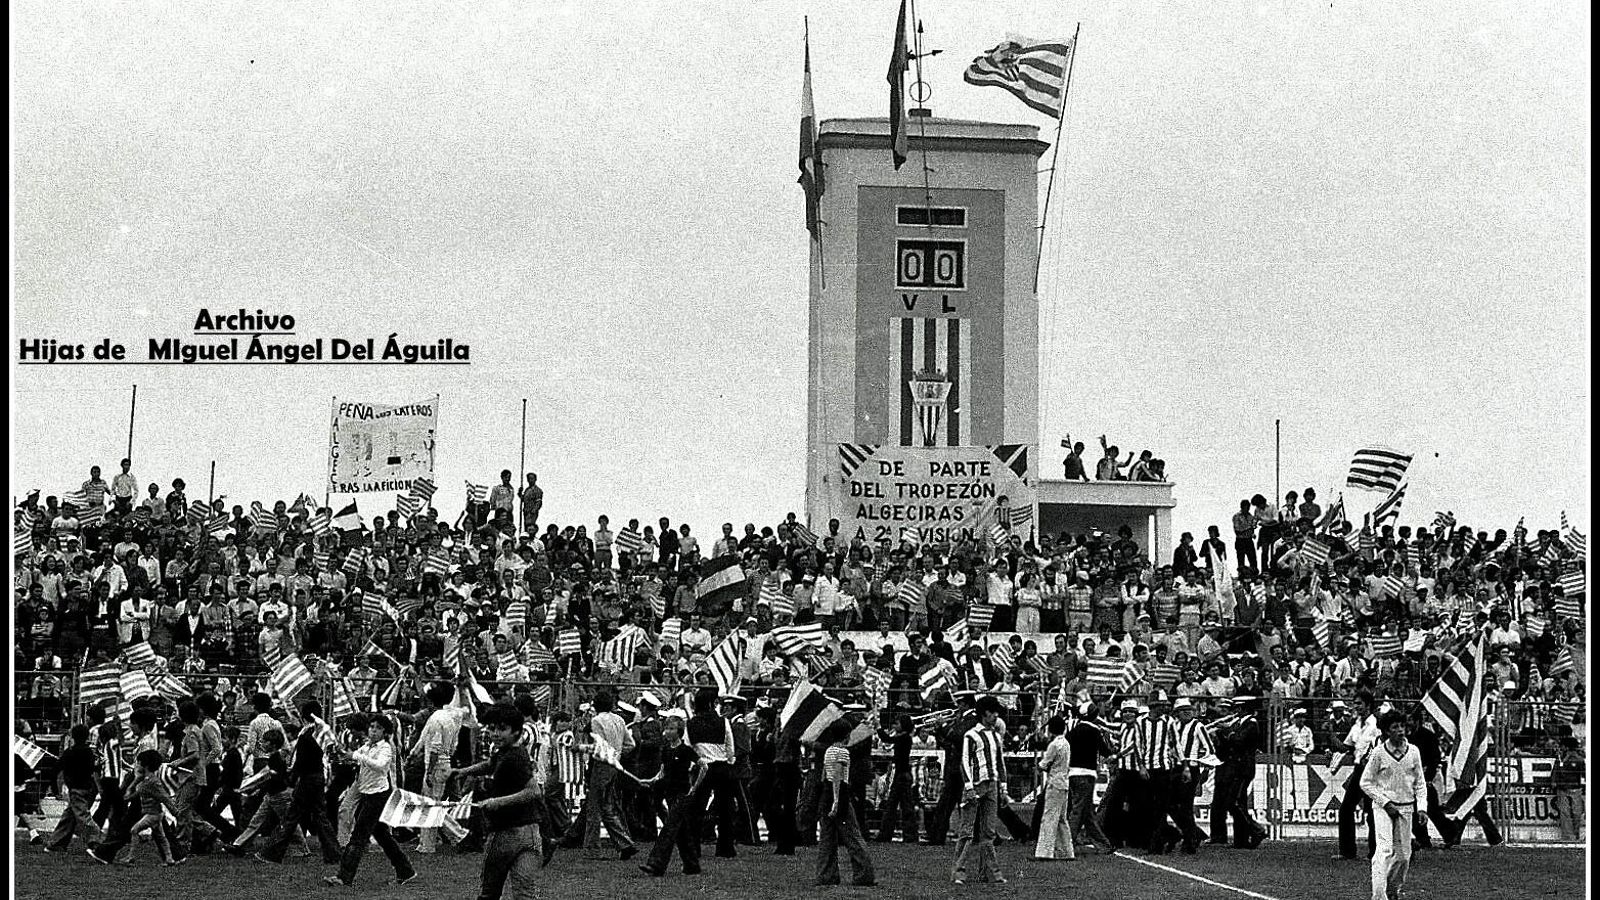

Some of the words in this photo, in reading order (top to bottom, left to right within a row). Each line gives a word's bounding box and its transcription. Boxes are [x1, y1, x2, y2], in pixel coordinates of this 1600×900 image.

[902, 294, 918, 311] V
[941, 295, 956, 313] L
[339, 402, 374, 420] PEÑA
[394, 404, 432, 417] LATEROS
[879, 460, 904, 477] DE
[930, 460, 991, 477] PARTE
[850, 480, 885, 498] DEL
[895, 478, 996, 499] TROPEZÓN
[856, 503, 965, 521] ALGECIRAS
[855, 525, 866, 542] A
[1292, 809, 1340, 823] ALGECI
